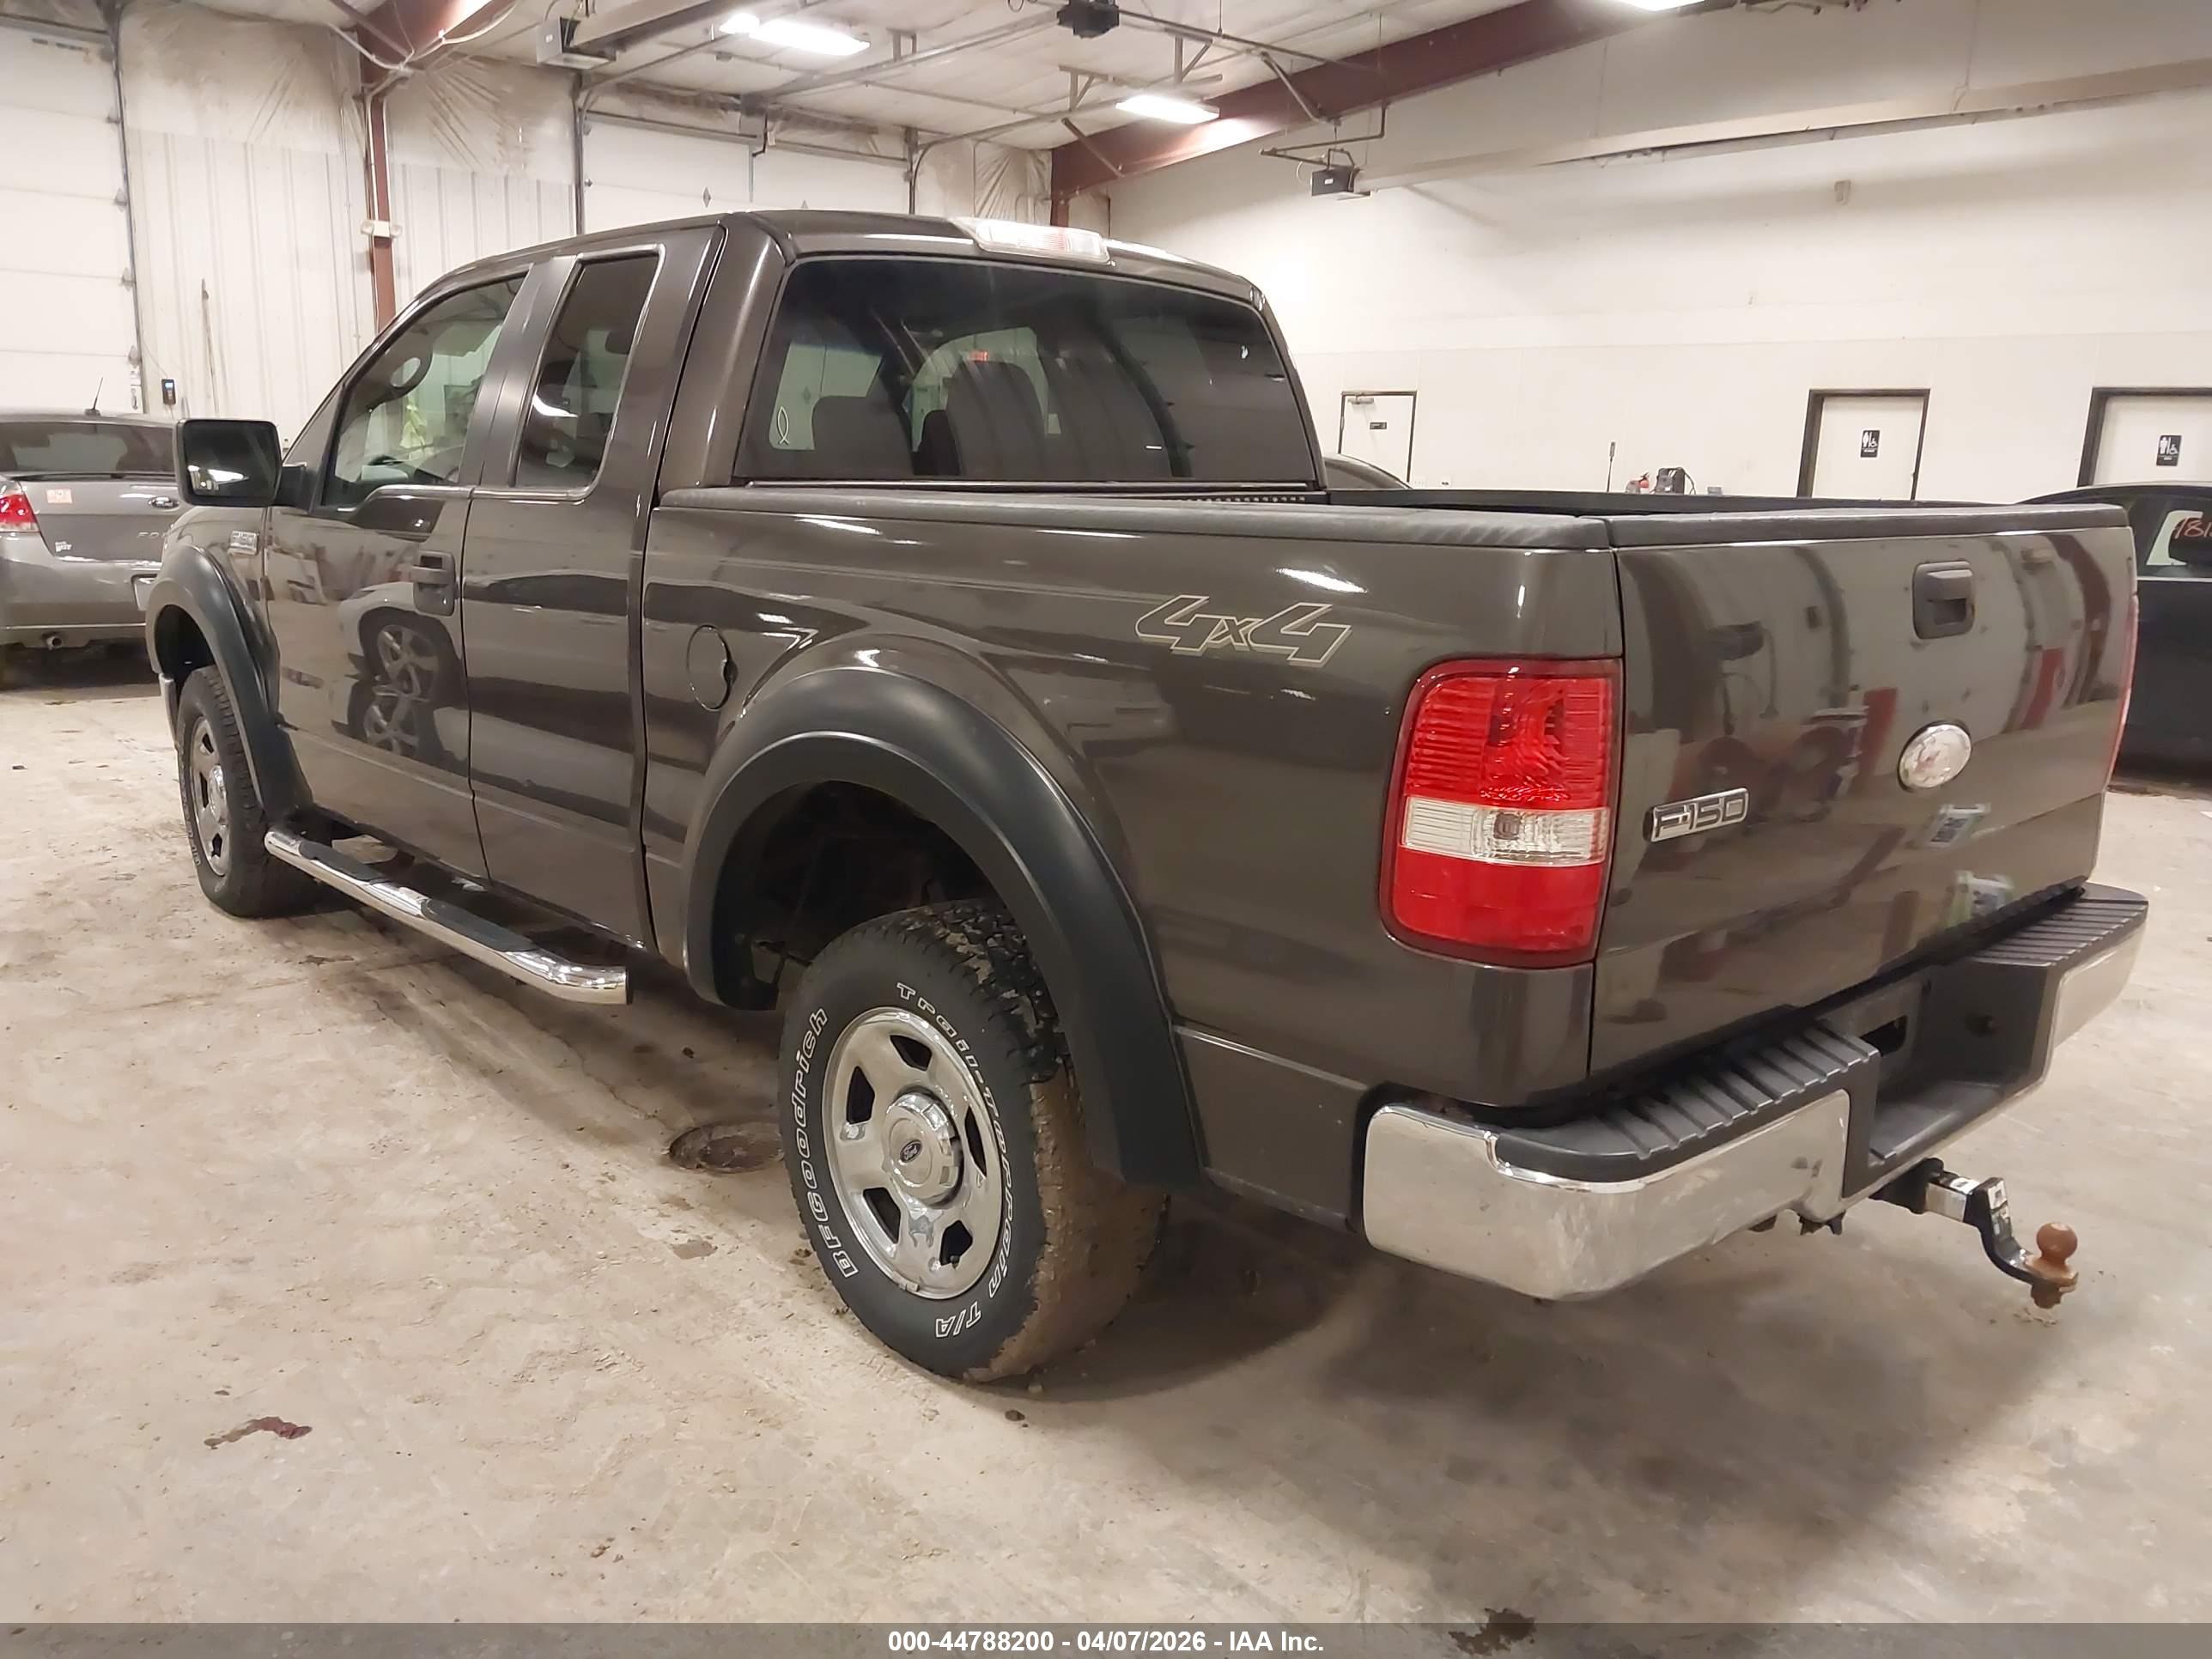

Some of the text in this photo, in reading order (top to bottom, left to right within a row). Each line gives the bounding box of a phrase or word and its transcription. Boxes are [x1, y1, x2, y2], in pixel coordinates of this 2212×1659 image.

[1135, 594, 1352, 667] 4x4
[1652, 787, 1749, 842] F-150
[790, 1006, 859, 1279] BFGoodrich
[935, 1300, 981, 1338] T/A
